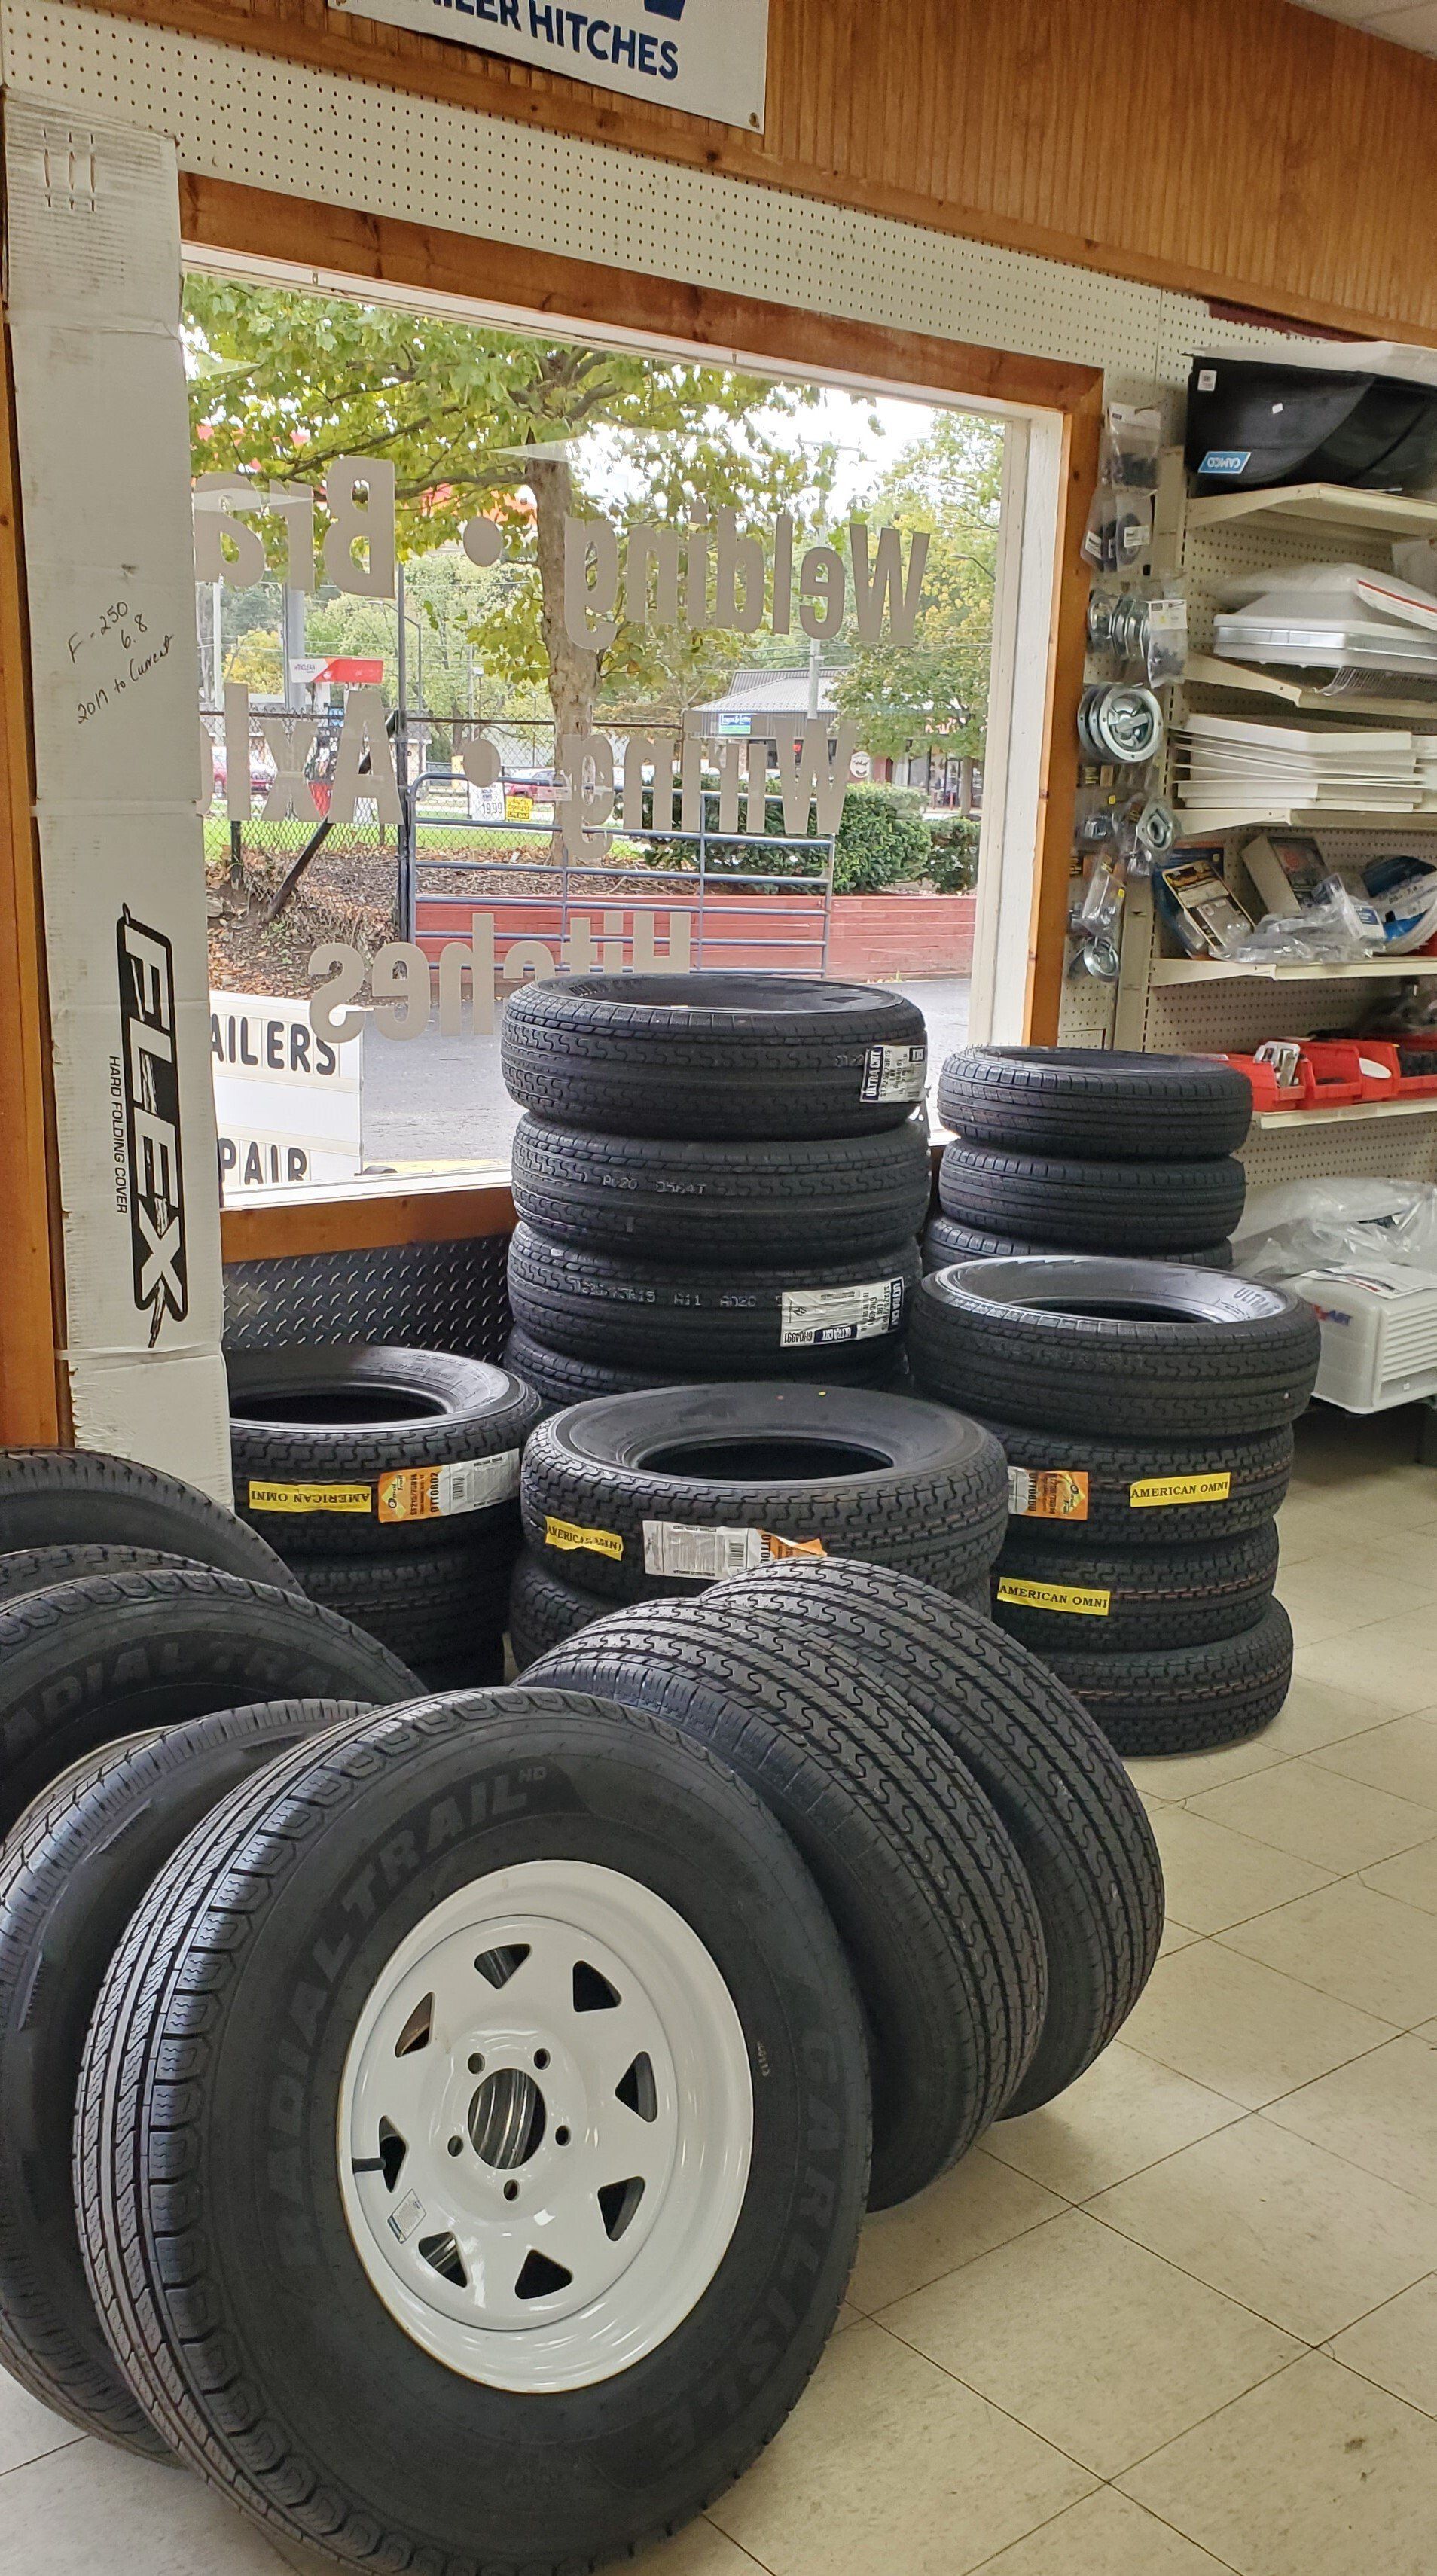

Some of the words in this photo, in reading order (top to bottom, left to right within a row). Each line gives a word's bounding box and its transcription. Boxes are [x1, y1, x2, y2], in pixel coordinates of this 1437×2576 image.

[529, 0, 679, 80] HITCHES
[1207, 456, 1240, 468] CAMCO
[121, 614, 148, 650] 6.8
[78, 689, 109, 724] 2017
[114, 678, 127, 694] to
[108, 1056, 121, 1098] HARD
[865, 1069, 880, 1097] ULTRA
[118, 913, 188, 1322] FLEX
[111, 1101, 125, 1163] FOLDING
[115, 1166, 128, 1214] COVER
[892, 1282, 902, 1309] ULTRA
[1233, 1287, 1274, 1312] ULTRA
[784, 1330, 813, 1344] 6H04991
[834, 1327, 852, 1340] ULTRA
[251, 1490, 288, 1502] OMNI
[293, 1492, 370, 1504] AMERICAN
[1131, 1485, 1197, 1498] AMERICAN
[1200, 1481, 1228, 1493] OMNI
[999, 1584, 1068, 1604] AMERICAN
[1072, 1596, 1107, 1608] OMNI
[267, 1932, 354, 2263] RADIAL
[341, 1773, 526, 1922] TRAIL
[519, 1767, 547, 1783] HD
